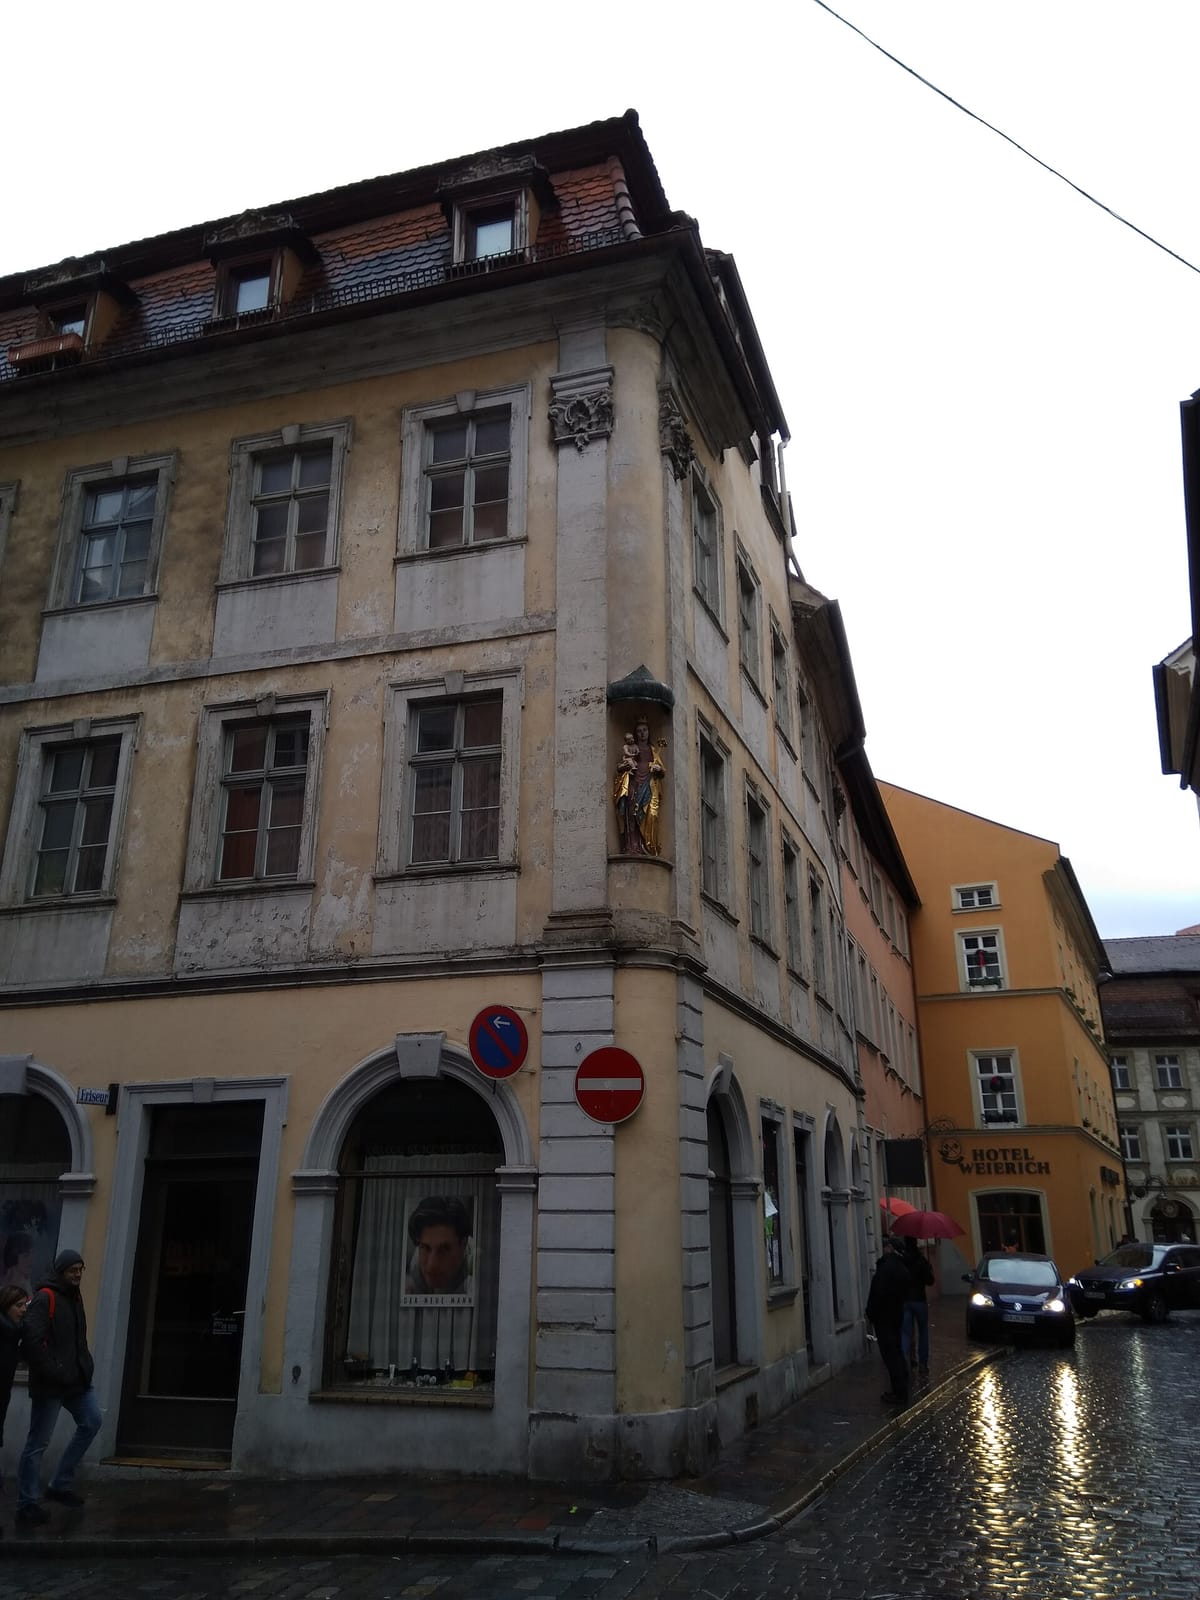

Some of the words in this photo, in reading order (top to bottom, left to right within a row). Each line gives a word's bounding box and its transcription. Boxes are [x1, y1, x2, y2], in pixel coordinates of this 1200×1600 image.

[80, 1089, 108, 1103] Friseur
[972, 1148, 1034, 1161] HOTEL
[960, 1161, 1051, 1175] WEIERICH
